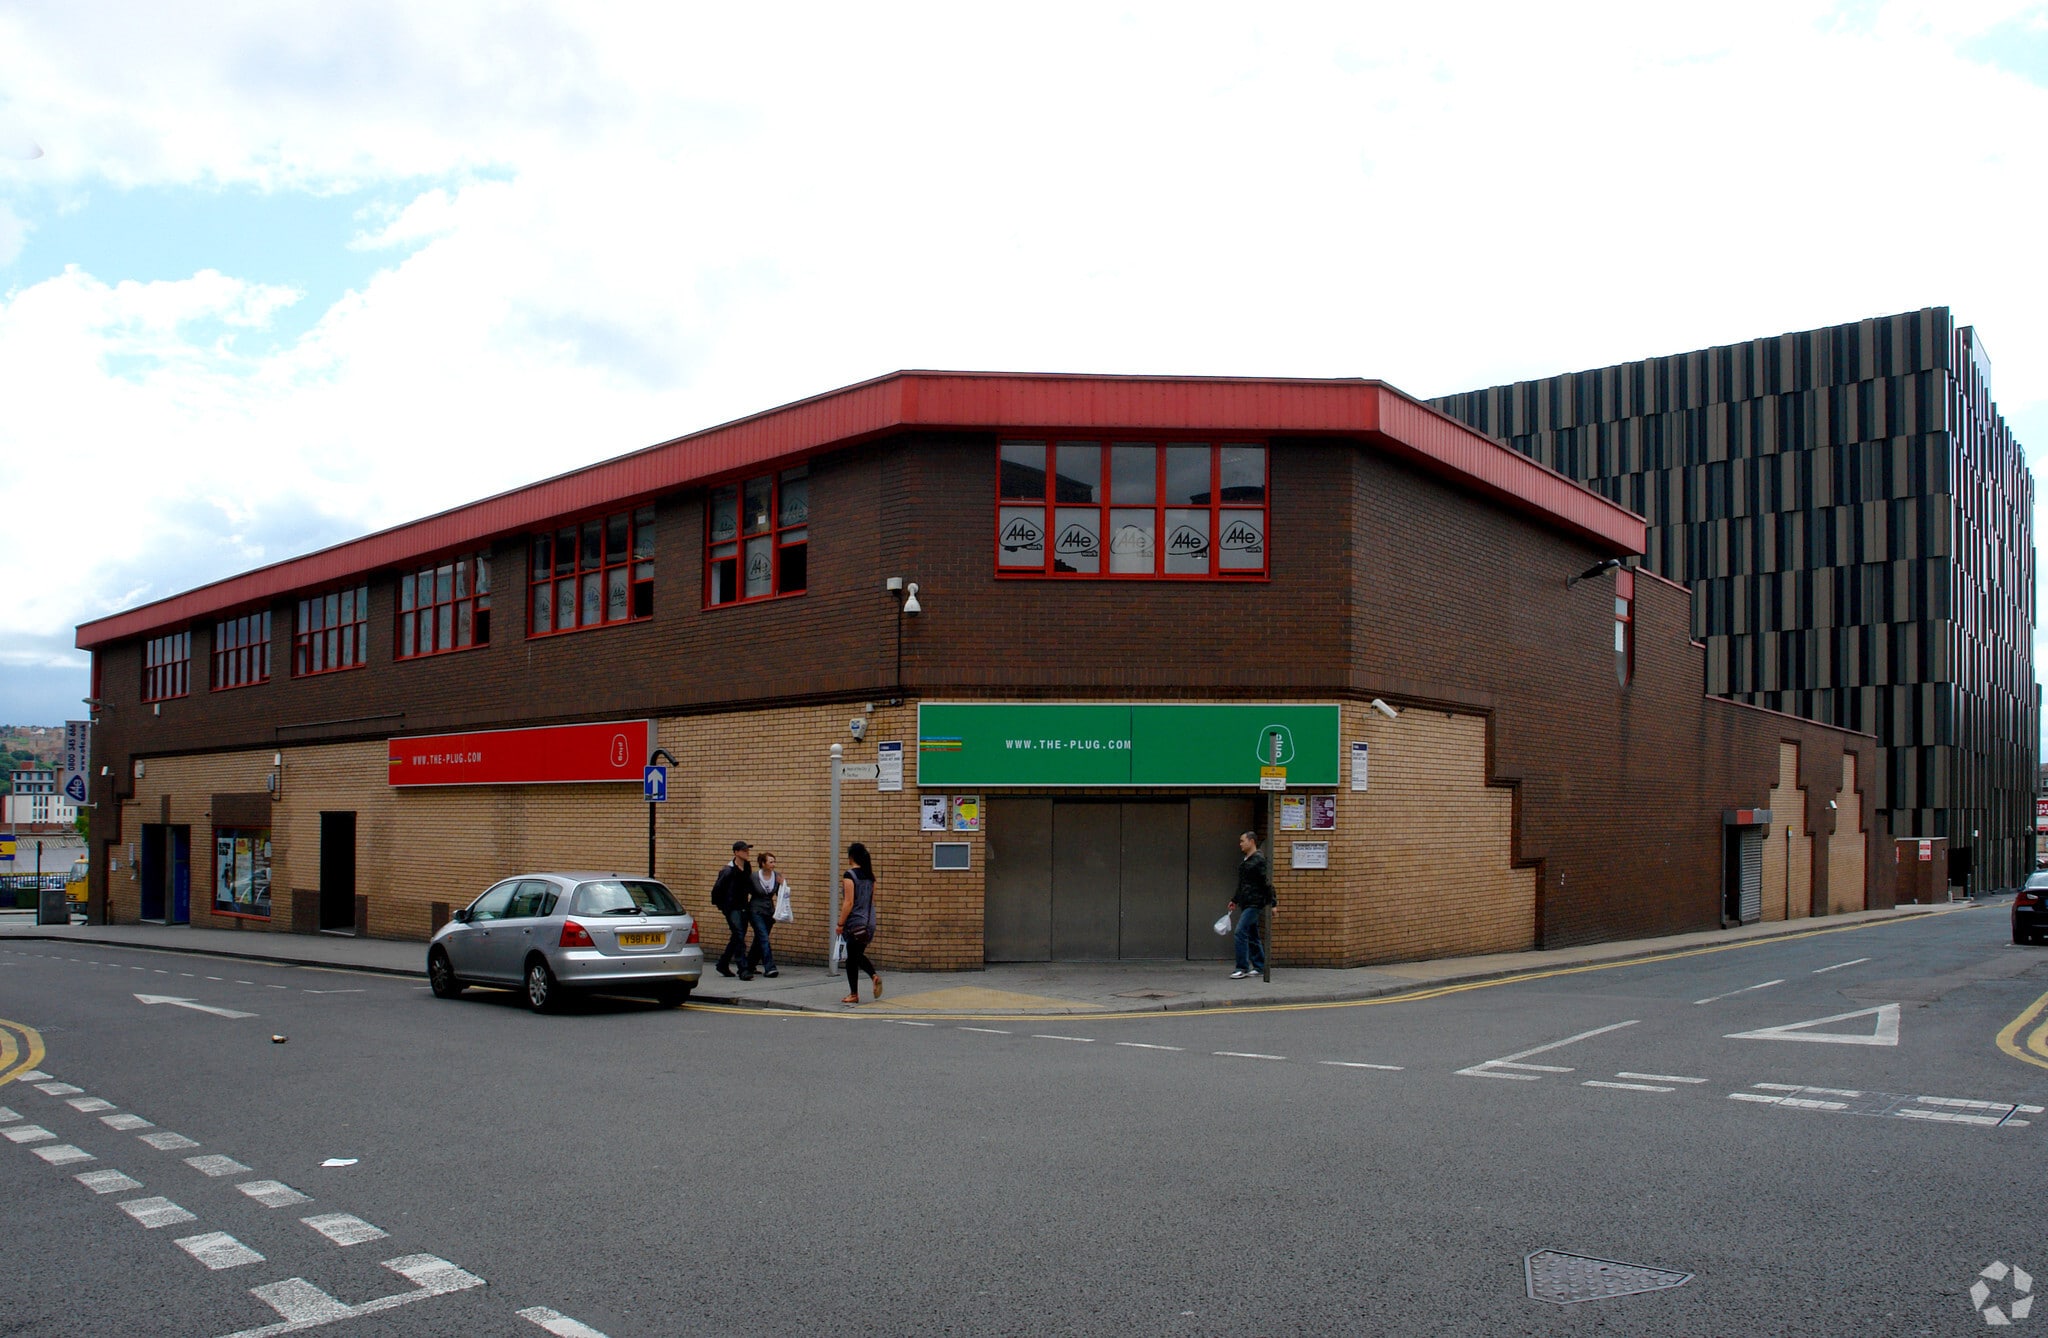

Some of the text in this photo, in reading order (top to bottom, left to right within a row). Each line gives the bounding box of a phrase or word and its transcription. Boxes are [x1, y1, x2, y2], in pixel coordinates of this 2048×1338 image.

[1006, 524, 1037, 542] A4e
[1061, 531, 1092, 548] A4e
[1171, 532, 1201, 549] A4e
[1226, 528, 1256, 544] A4e
[68, 739, 76, 751] 345
[1005, 739, 1131, 750] WWW.THE-PLUG.COM
[68, 754, 76, 771] 0800
[412, 751, 482, 766] WWW.THE-PLUG.COM
[68, 778, 83, 799] A4e
[624, 934, 661, 944] Y981 FAN
